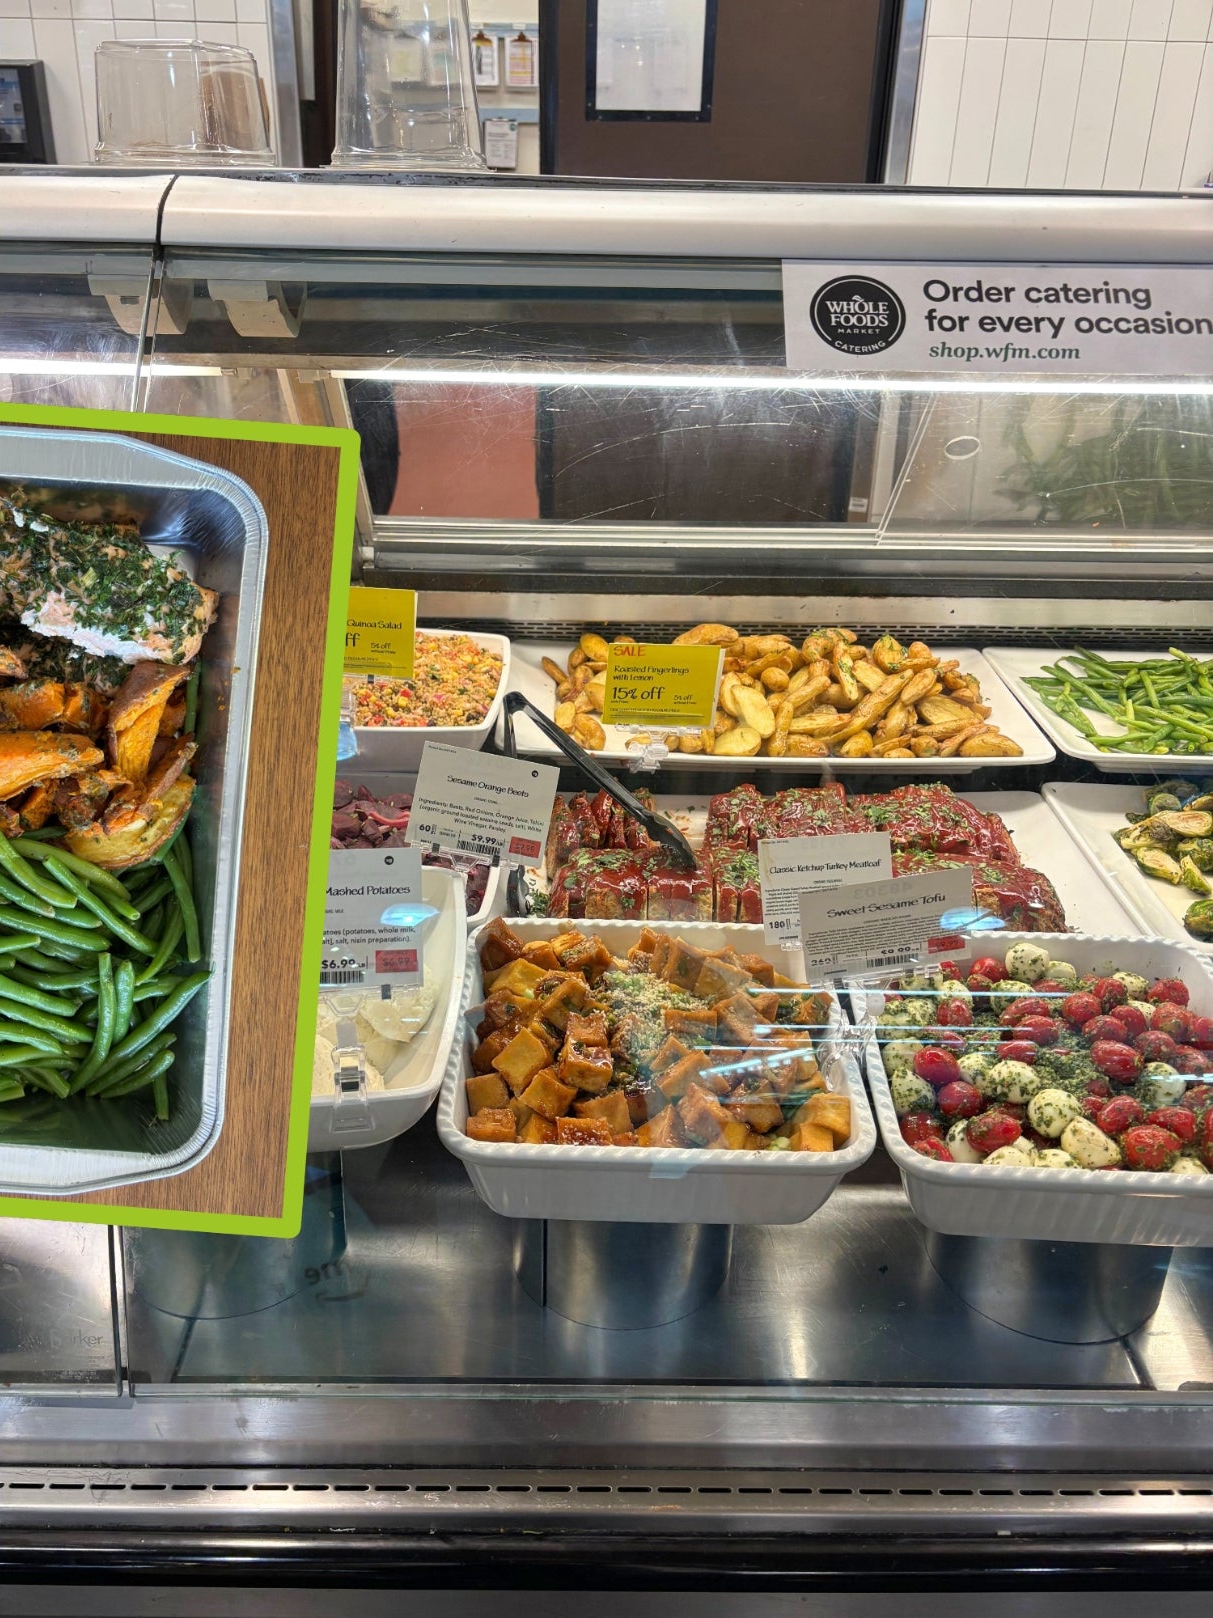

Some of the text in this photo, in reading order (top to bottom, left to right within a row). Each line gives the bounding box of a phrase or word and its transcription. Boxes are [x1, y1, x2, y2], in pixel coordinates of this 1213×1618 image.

[922, 279, 1152, 310] Order catering
[825, 299, 890, 315] WHOLE
[830, 313, 889, 328] FOODS
[924, 308, 1213, 339] for every occasion
[834, 339, 887, 354] CATERING
[929, 341, 1081, 362] shop.wfm.com
[347, 618, 402, 630] Quinoa Salad
[346, 632, 361, 647] ff
[613, 645, 646, 657] SALE
[614, 665, 690, 675] Roasted Fingerlings
[613, 686, 638, 700] 15%
[641, 686, 666, 700] off
[447, 775, 529, 798] Sesame Orange Beets
[419, 823, 431, 832] 60
[769, 859, 882, 874] Classic Ketchup Turkey Meatloaf
[366, 885, 411, 896] Potatoes
[827, 893, 946, 918] Sweet Sesame Tofu
[769, 921, 786, 929] 180
